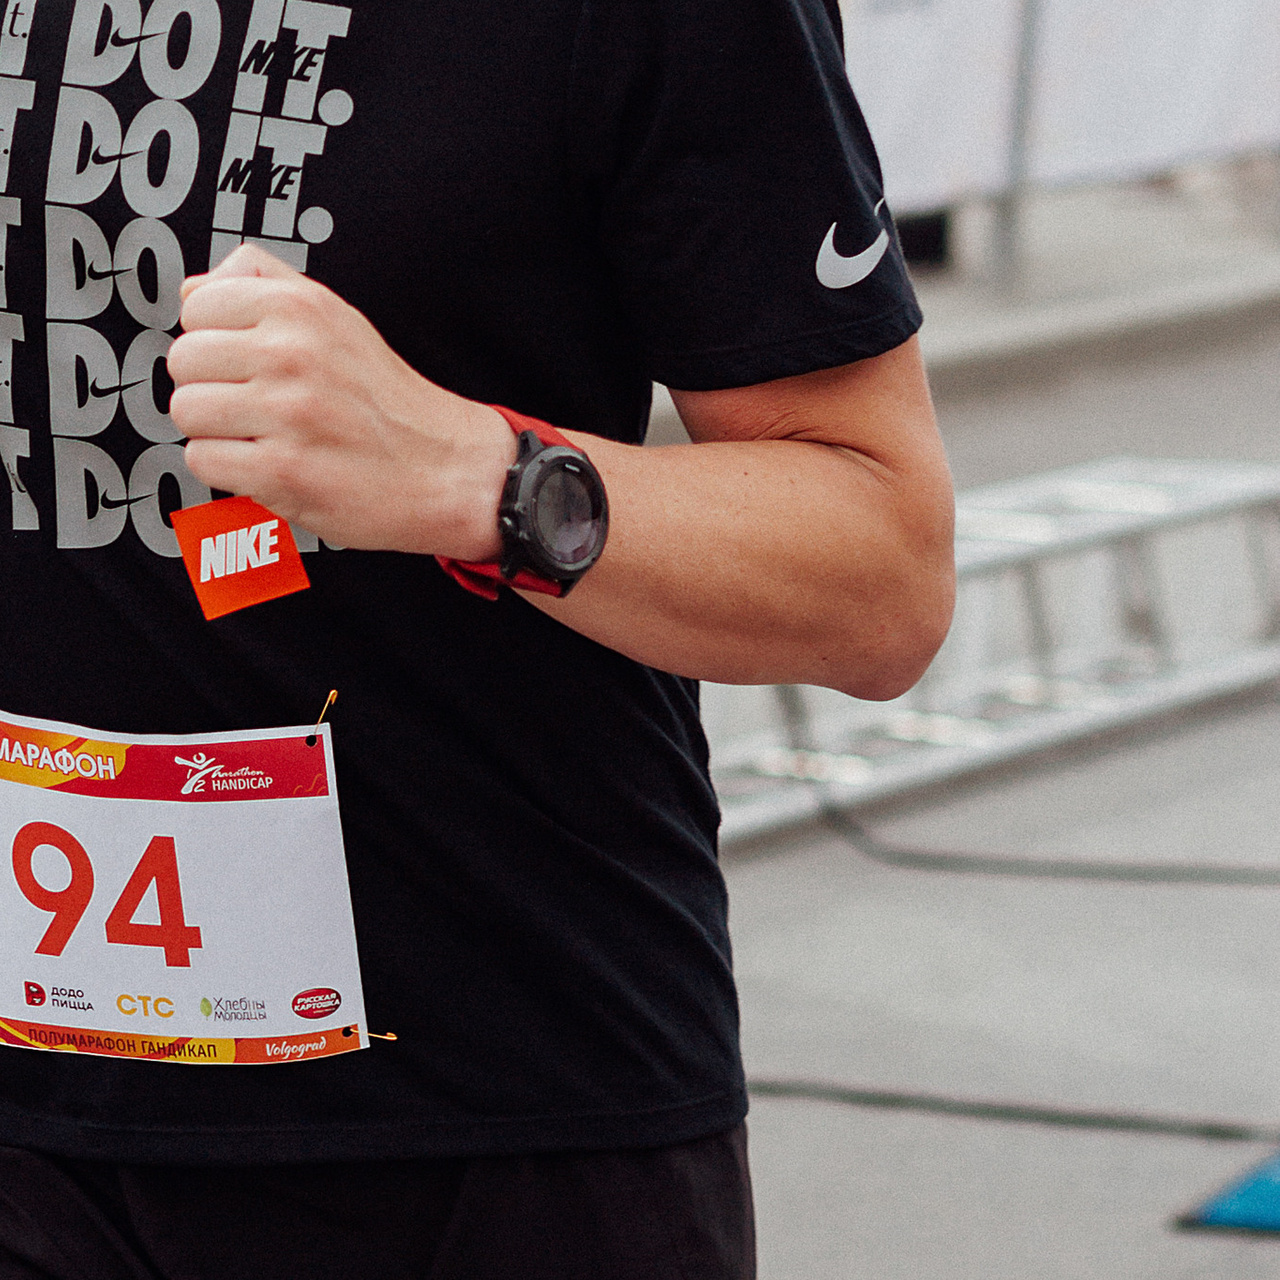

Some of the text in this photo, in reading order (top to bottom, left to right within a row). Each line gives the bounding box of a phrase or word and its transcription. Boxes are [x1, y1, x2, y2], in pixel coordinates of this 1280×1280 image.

[238, 39, 326, 82] NKE
[45, 85, 200, 217] DO
[212, 111, 334, 244] IT.
[217, 158, 303, 200] NKE
[45, 205, 185, 331] DO
[47, 322, 177, 443] DO
[52, 437, 214, 558] DO
[200, 519, 280, 583] NIKE
[212, 776, 274, 791] HANDICAP
[11, 820, 204, 968] 94
[51, 986, 85, 998] ДОДО
[51, 998, 95, 1011] ПИЦЦА
[116, 994, 176, 1018] СТС
[28, 1028, 218, 1058] ПОЛУМАРАФОН ГАНДИКАП
[265, 1036, 327, 1060] Volgograd
